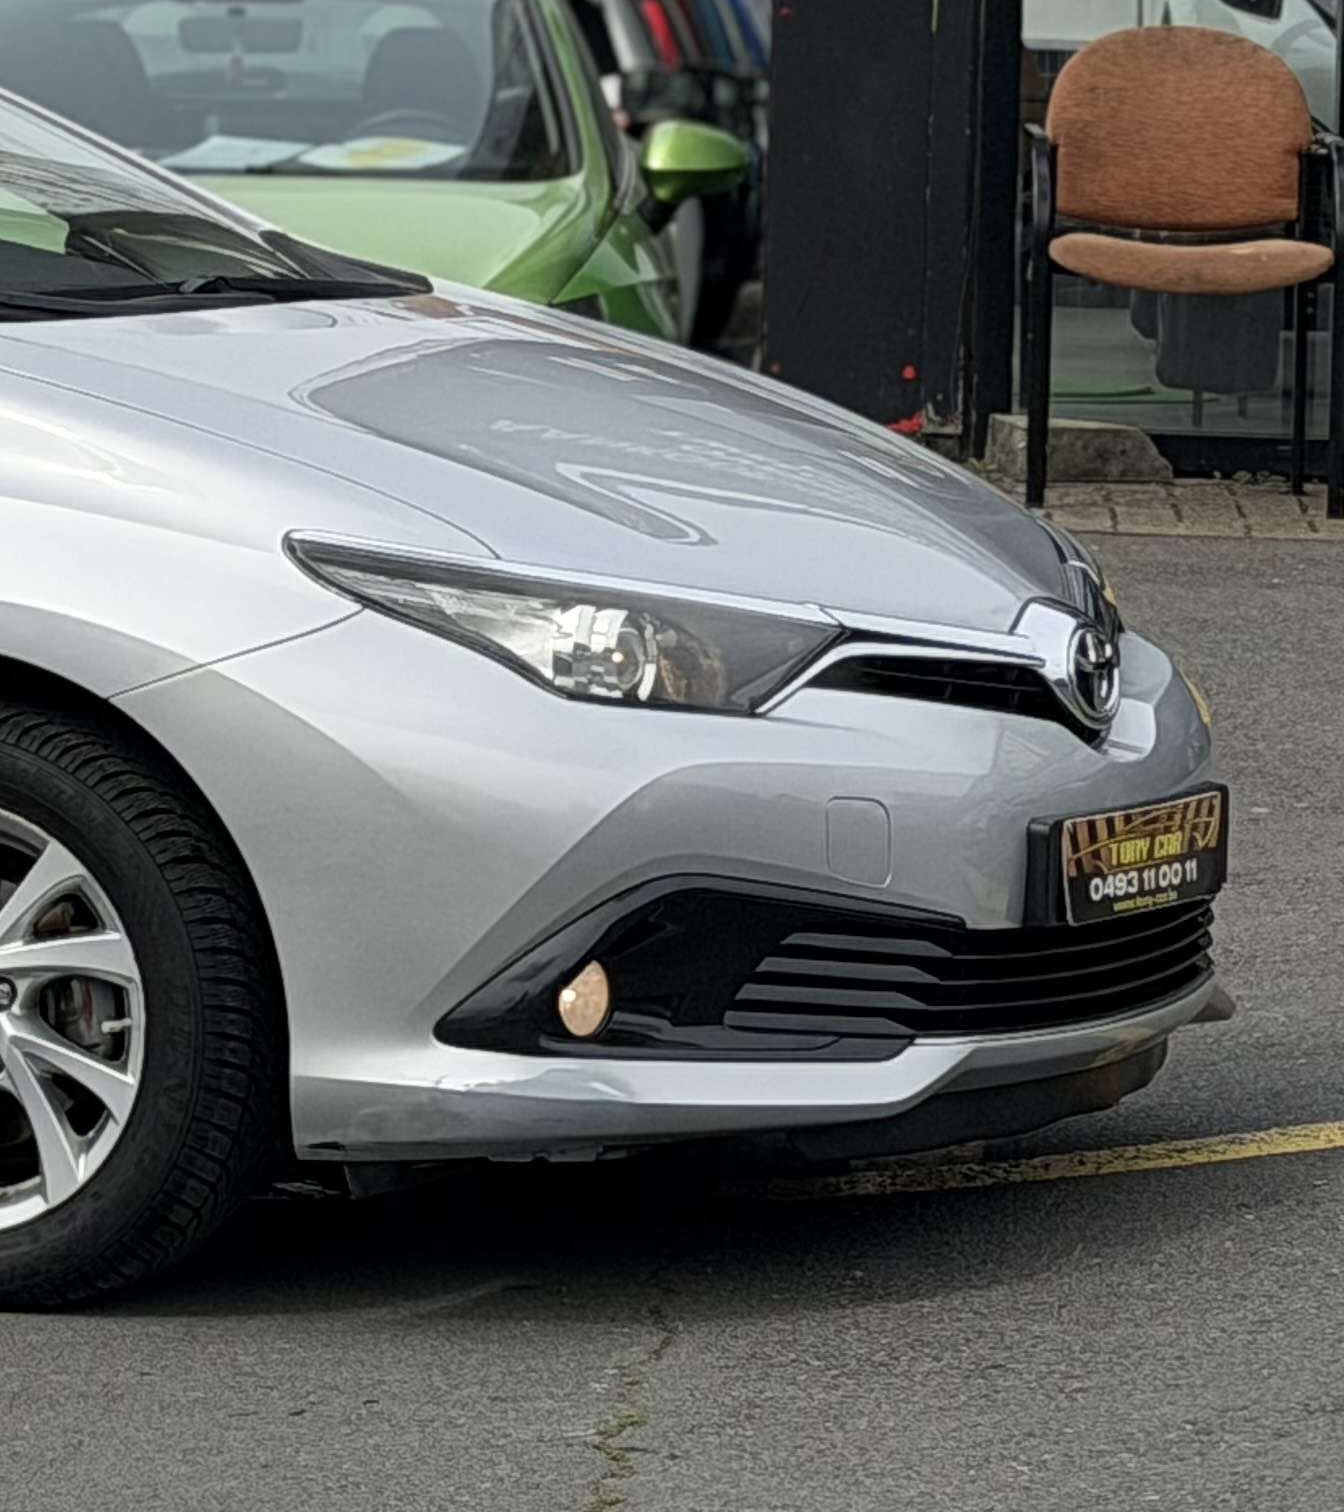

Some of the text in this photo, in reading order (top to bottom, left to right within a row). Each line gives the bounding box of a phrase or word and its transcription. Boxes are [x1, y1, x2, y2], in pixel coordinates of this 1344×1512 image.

[1153, 831, 1183, 859] CAR
[1089, 857, 1198, 902] 0493 11 00 11
